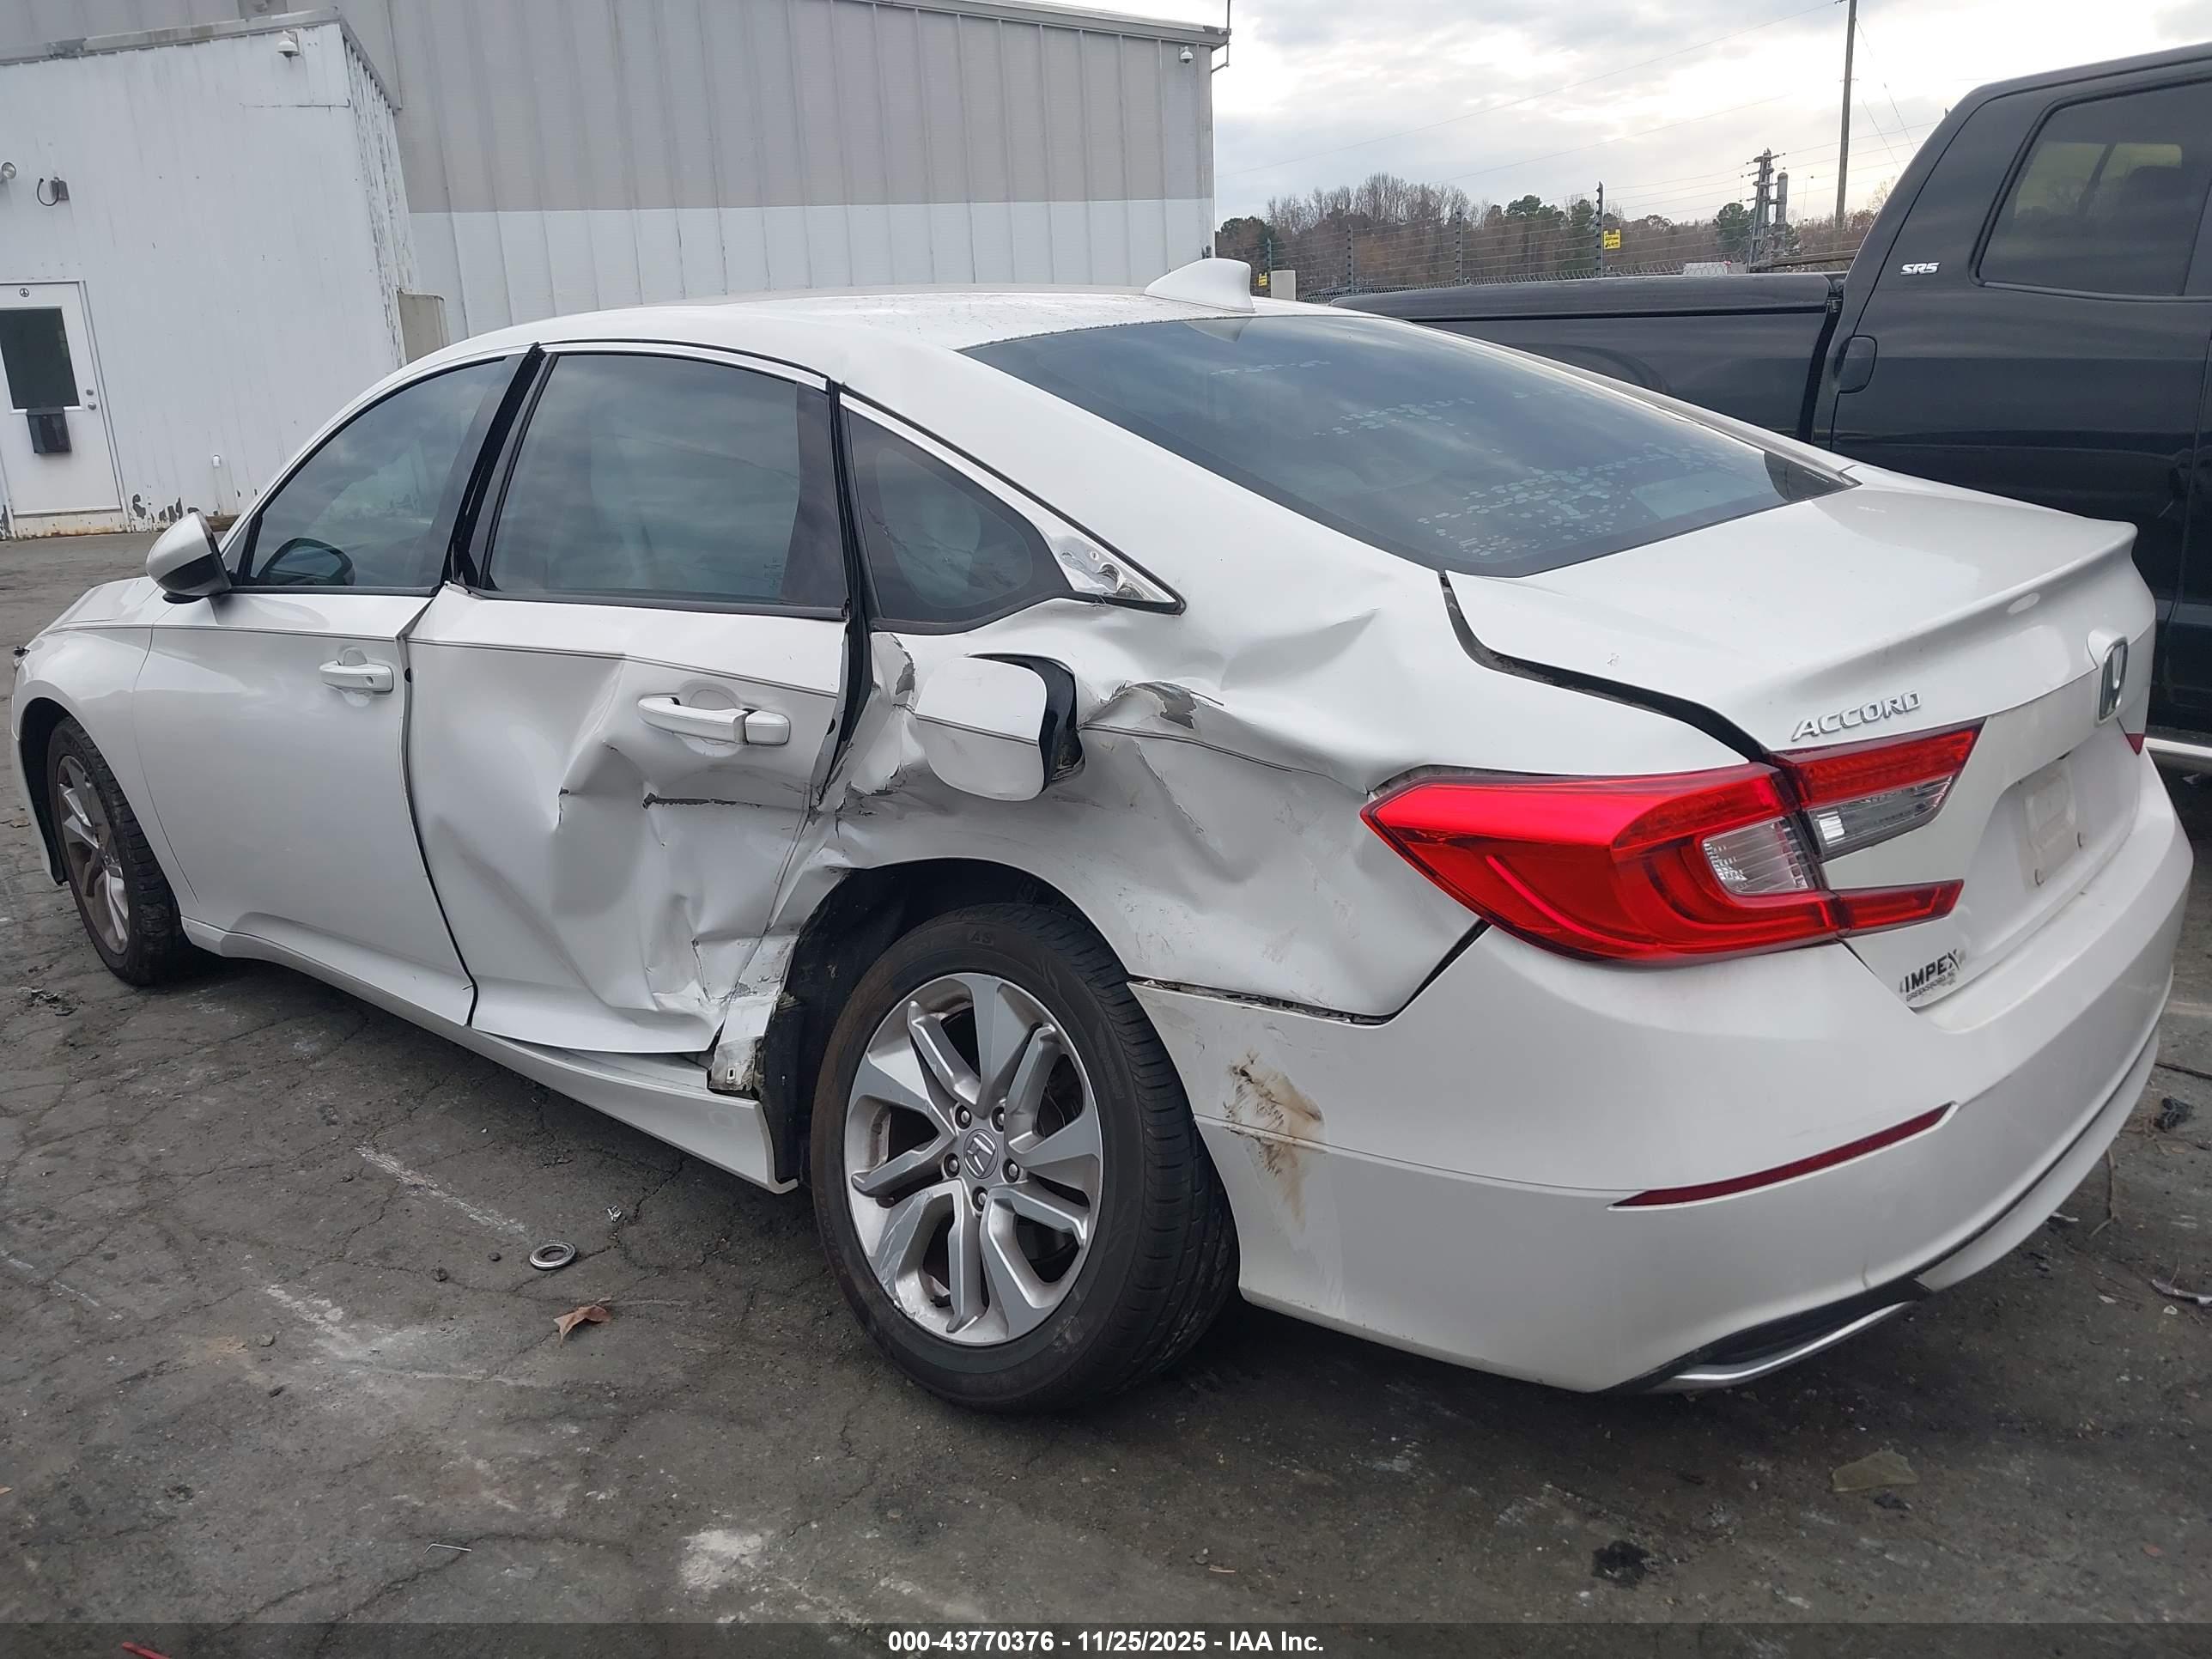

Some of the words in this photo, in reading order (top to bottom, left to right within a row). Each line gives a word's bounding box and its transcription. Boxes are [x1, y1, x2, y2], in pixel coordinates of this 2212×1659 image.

[1900, 262, 1940, 275] SR5
[1791, 691, 1922, 742] ACCORD
[1905, 948, 1960, 994] IMPEX
